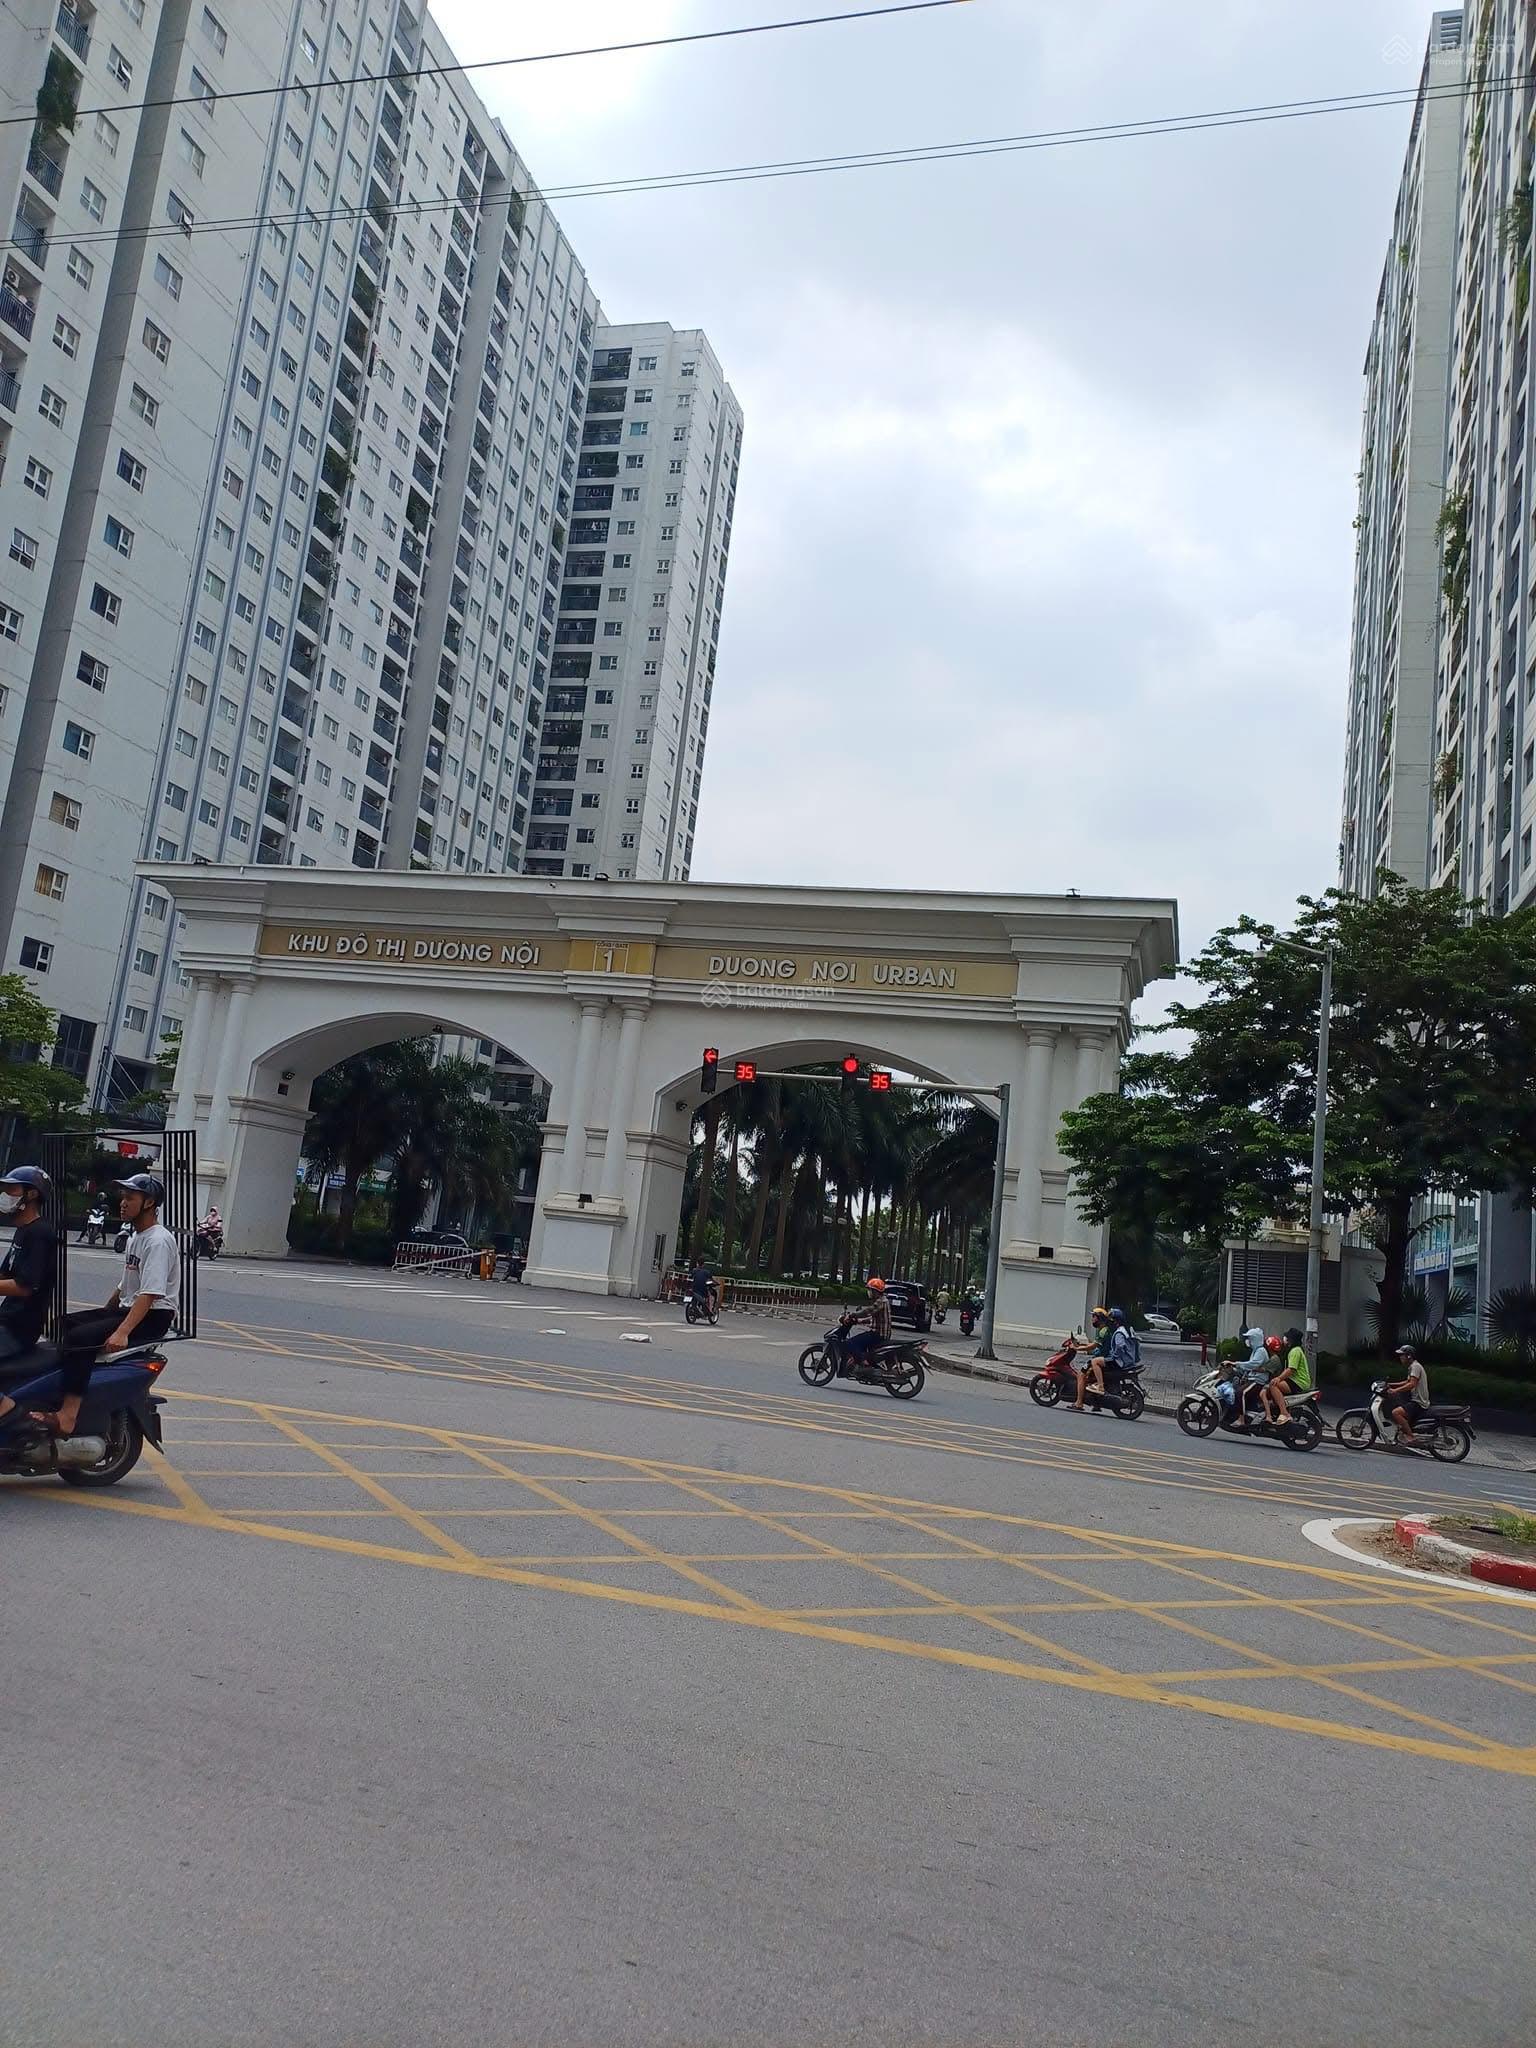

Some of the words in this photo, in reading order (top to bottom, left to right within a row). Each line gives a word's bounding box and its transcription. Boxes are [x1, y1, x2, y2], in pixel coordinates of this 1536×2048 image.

[288, 933, 330, 953] KHU
[336, 932, 369, 955] ĐÔ
[376, 938, 407, 961] THỊ
[413, 939, 493, 962] DƯƠNG
[500, 940, 540, 969] NỘI
[603, 949, 614, 973] 1
[708, 955, 797, 979] DUONG
[812, 960, 857, 982] NOI
[873, 963, 957, 988] URBAN
[736, 1064, 754, 1080] 35
[871, 1074, 889, 1090] 35
